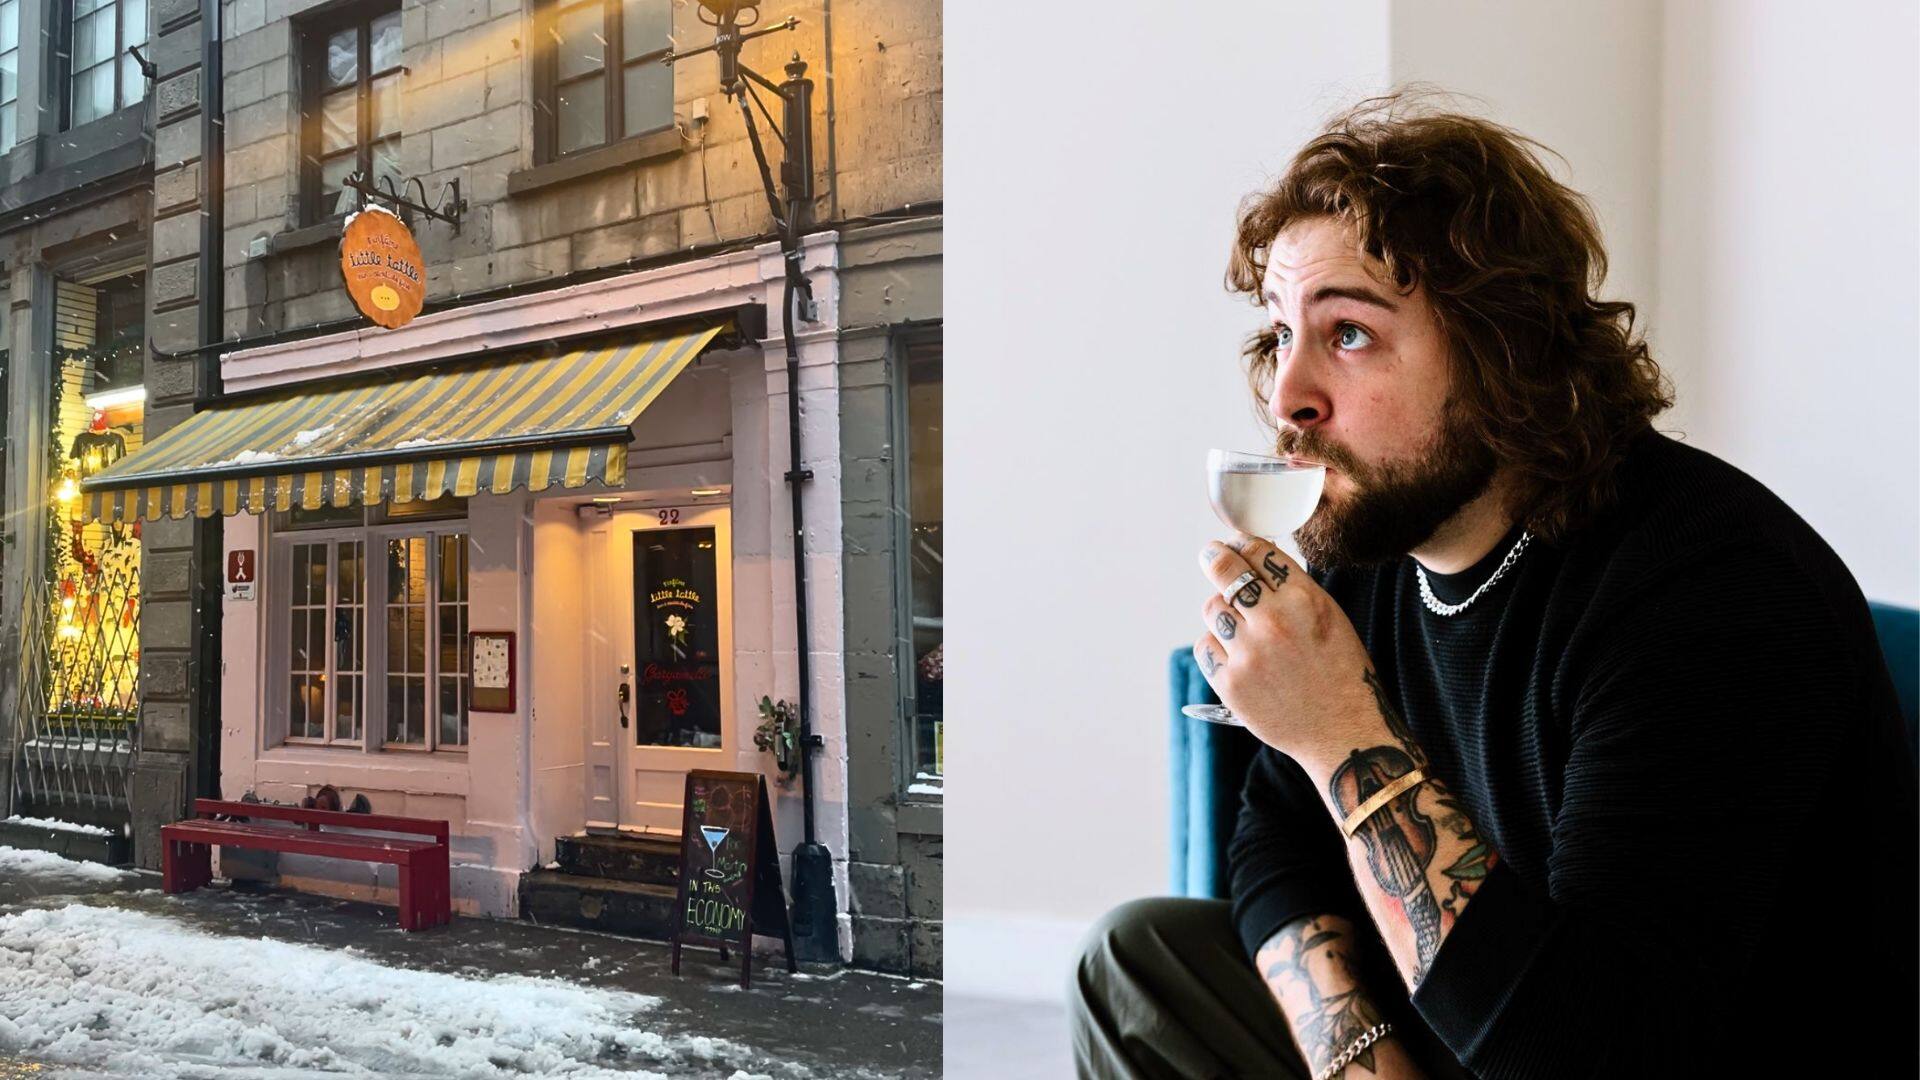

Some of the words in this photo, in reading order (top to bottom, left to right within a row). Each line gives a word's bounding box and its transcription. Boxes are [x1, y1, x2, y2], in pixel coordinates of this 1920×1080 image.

[658, 508, 680, 526] 22
[689, 879, 698, 892] IN
[687, 896, 746, 932] ECONOMY
